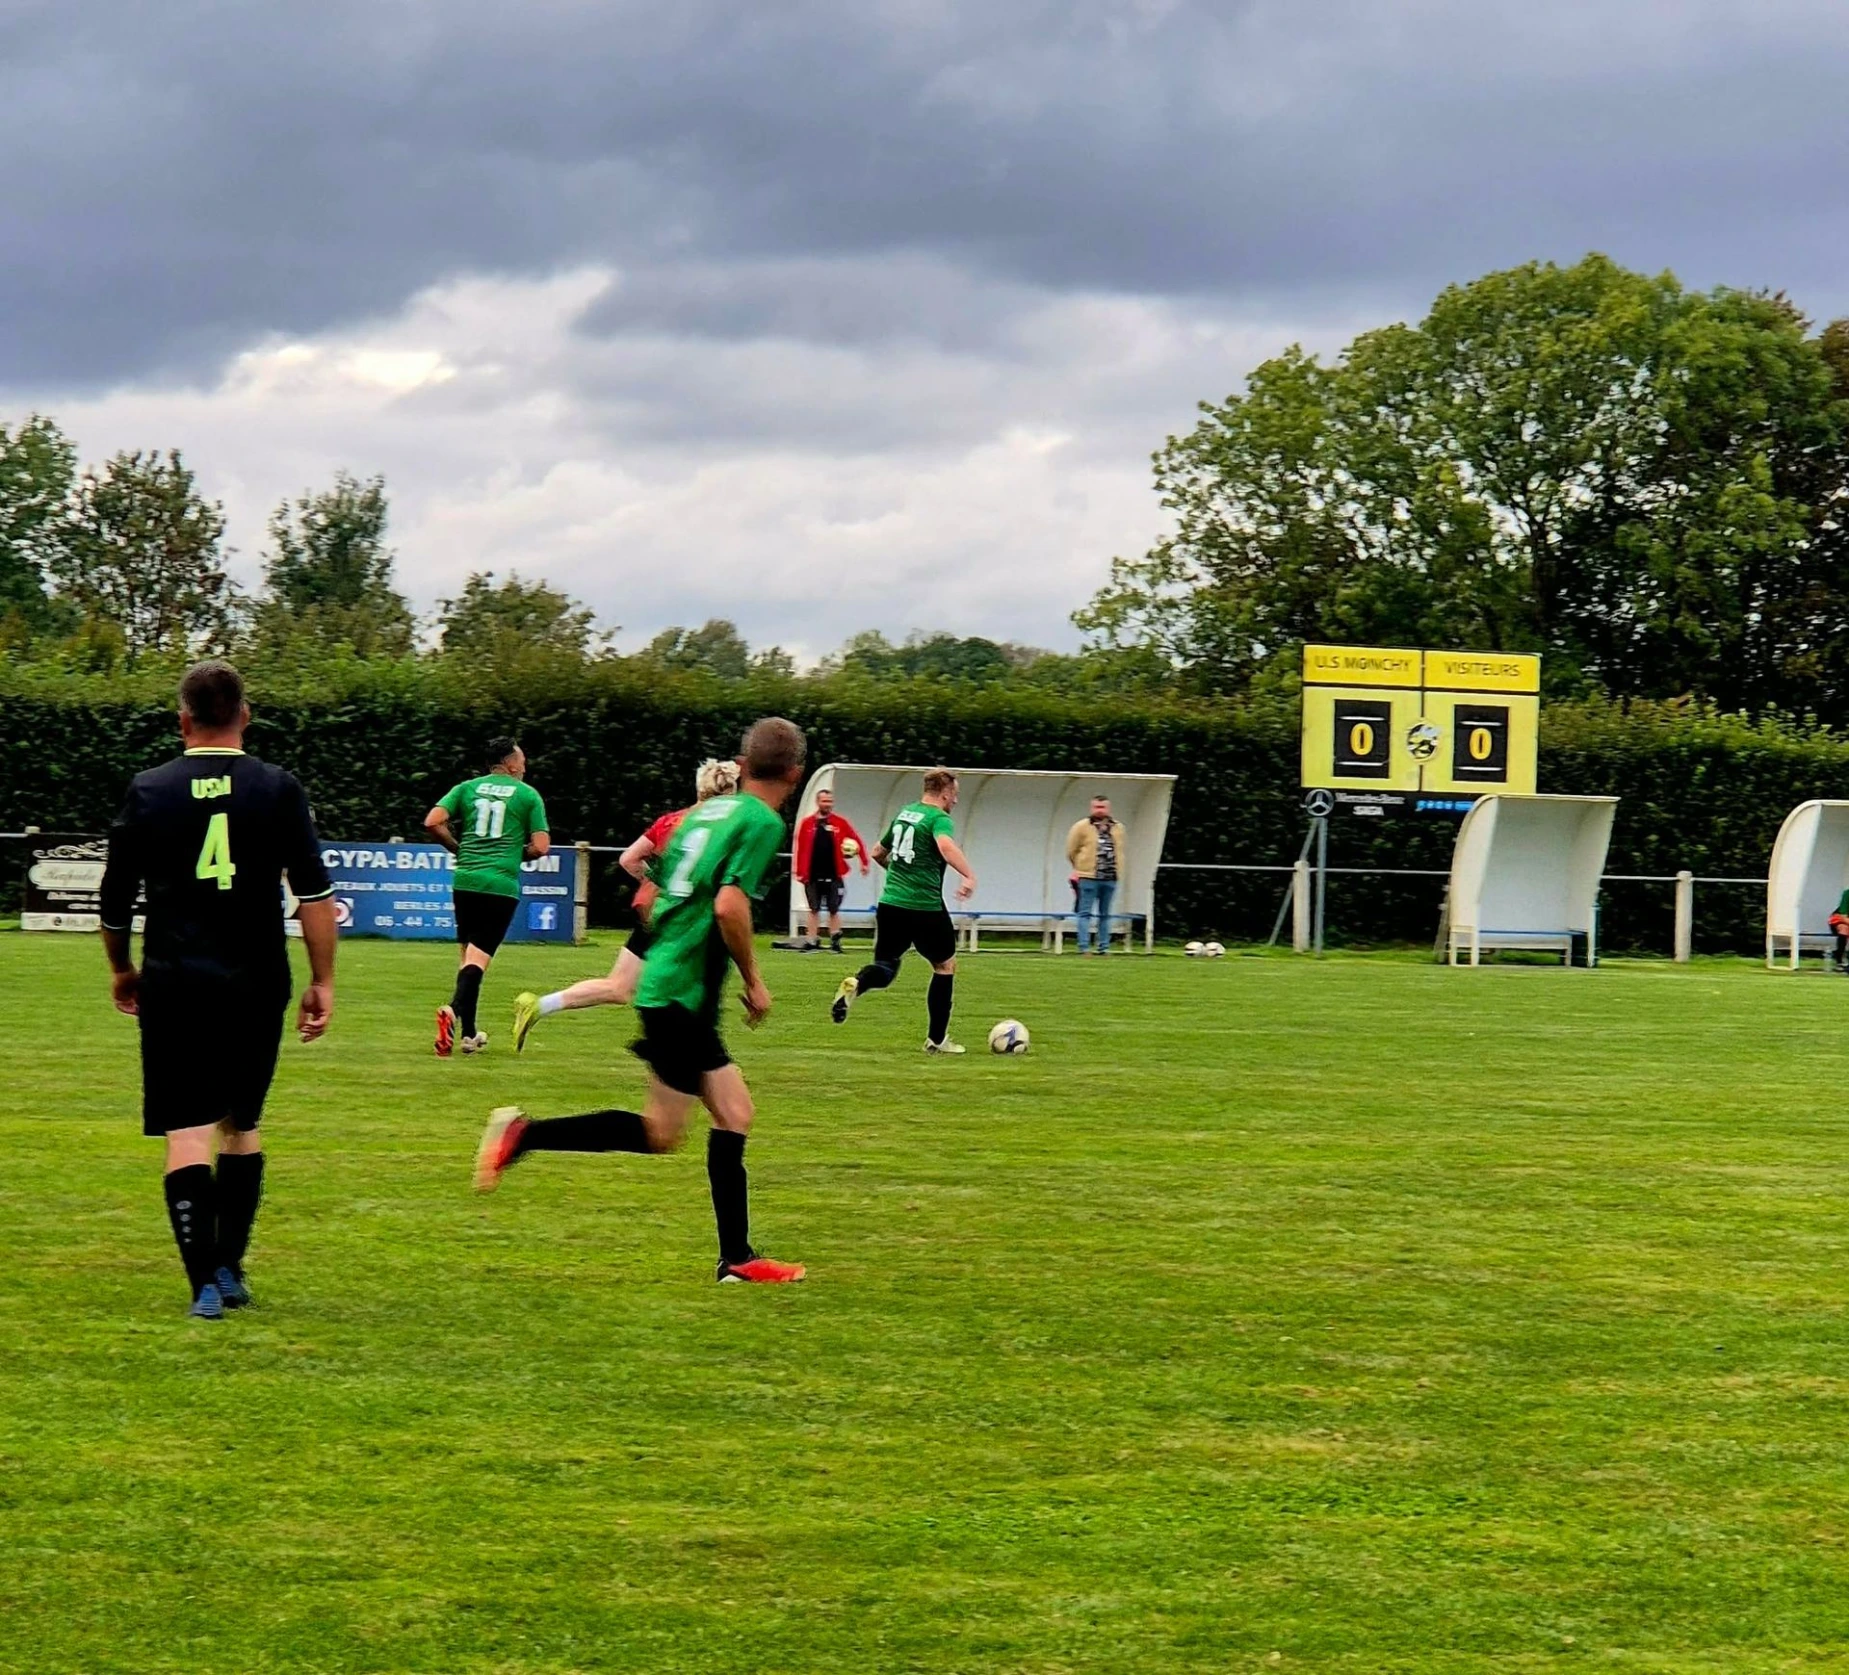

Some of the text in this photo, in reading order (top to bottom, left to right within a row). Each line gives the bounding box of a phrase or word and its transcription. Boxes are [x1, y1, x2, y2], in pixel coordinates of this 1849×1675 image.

[1443, 661, 1519, 677] VISITEURS
[1350, 723, 1374, 756] 0
[1470, 727, 1492, 760] 0
[474, 798, 506, 838] 11
[196, 813, 236, 890] 4
[320, 849, 457, 870] CYPA-BATE
[892, 823, 915, 864] 14
